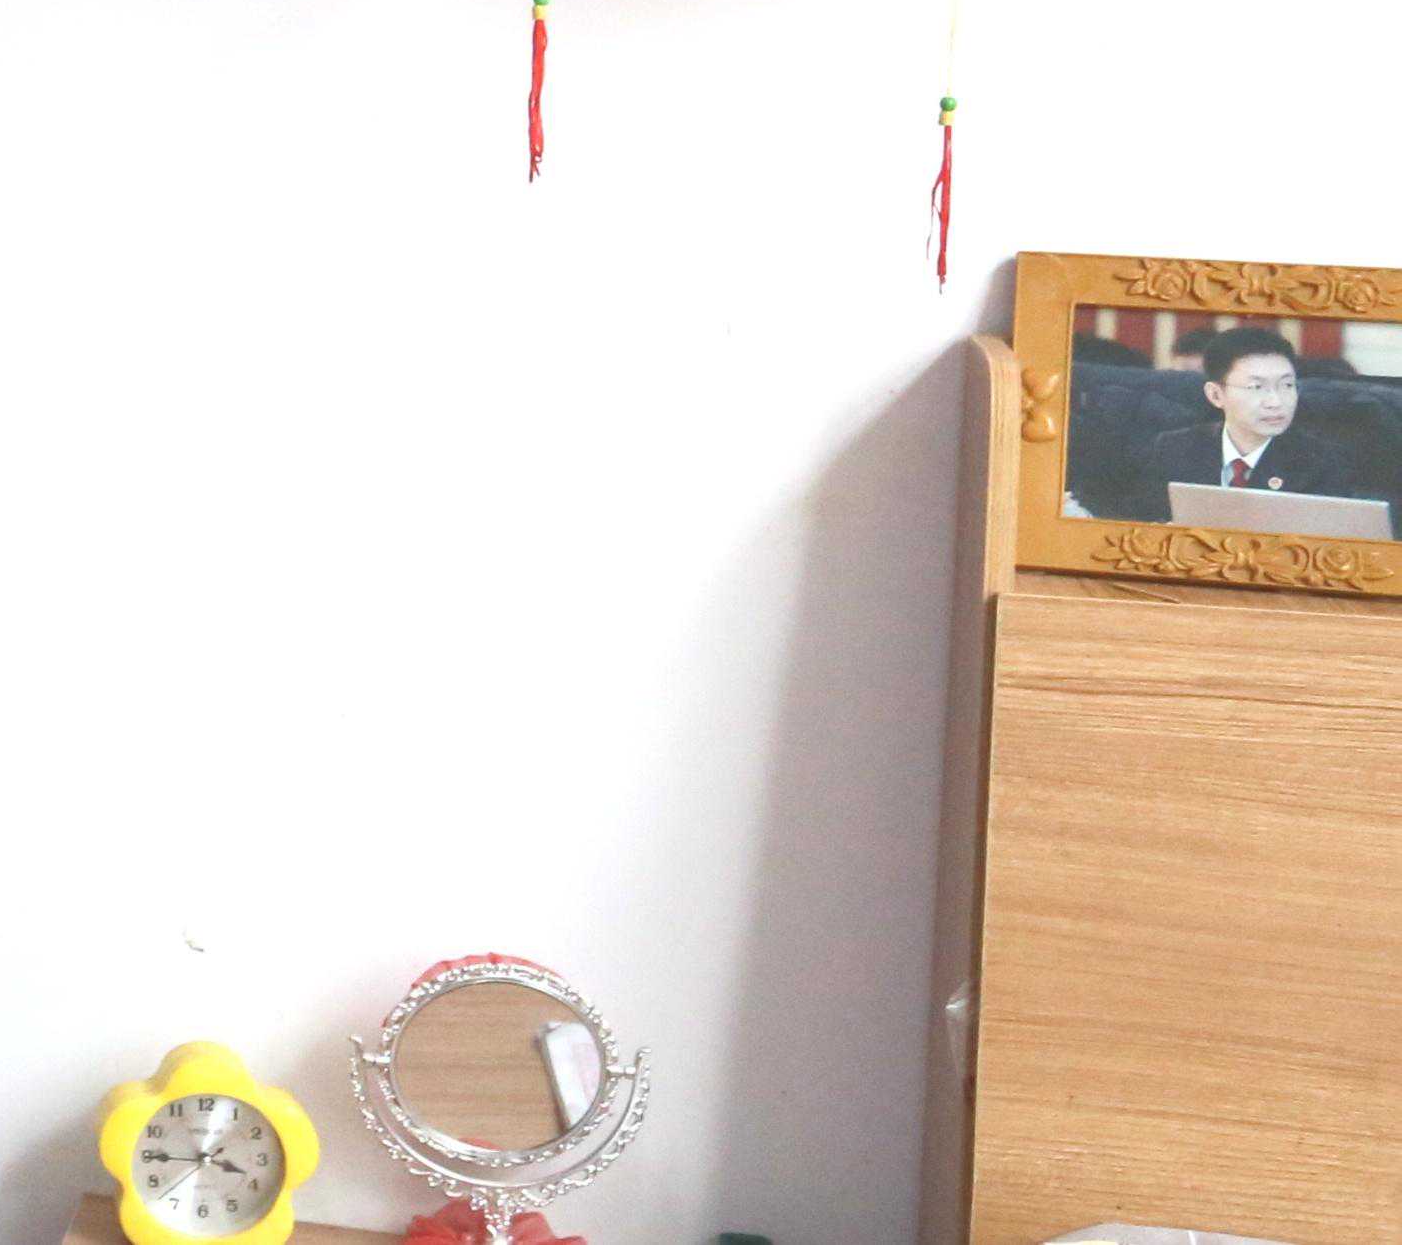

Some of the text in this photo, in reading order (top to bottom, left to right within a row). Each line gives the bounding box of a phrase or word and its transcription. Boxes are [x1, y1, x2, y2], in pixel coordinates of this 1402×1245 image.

[169, 1104, 183, 1117] 11
[198, 1098, 215, 1112] 12
[147, 1125, 163, 1139] 10
[250, 1126, 262, 1140] 2
[256, 1153, 268, 1167] 3
[148, 1174, 159, 1188] 8
[248, 1178, 259, 1191] 4
[169, 1197, 180, 1210] 7
[226, 1199, 238, 1213] 5
[197, 1204, 209, 1218] 6
